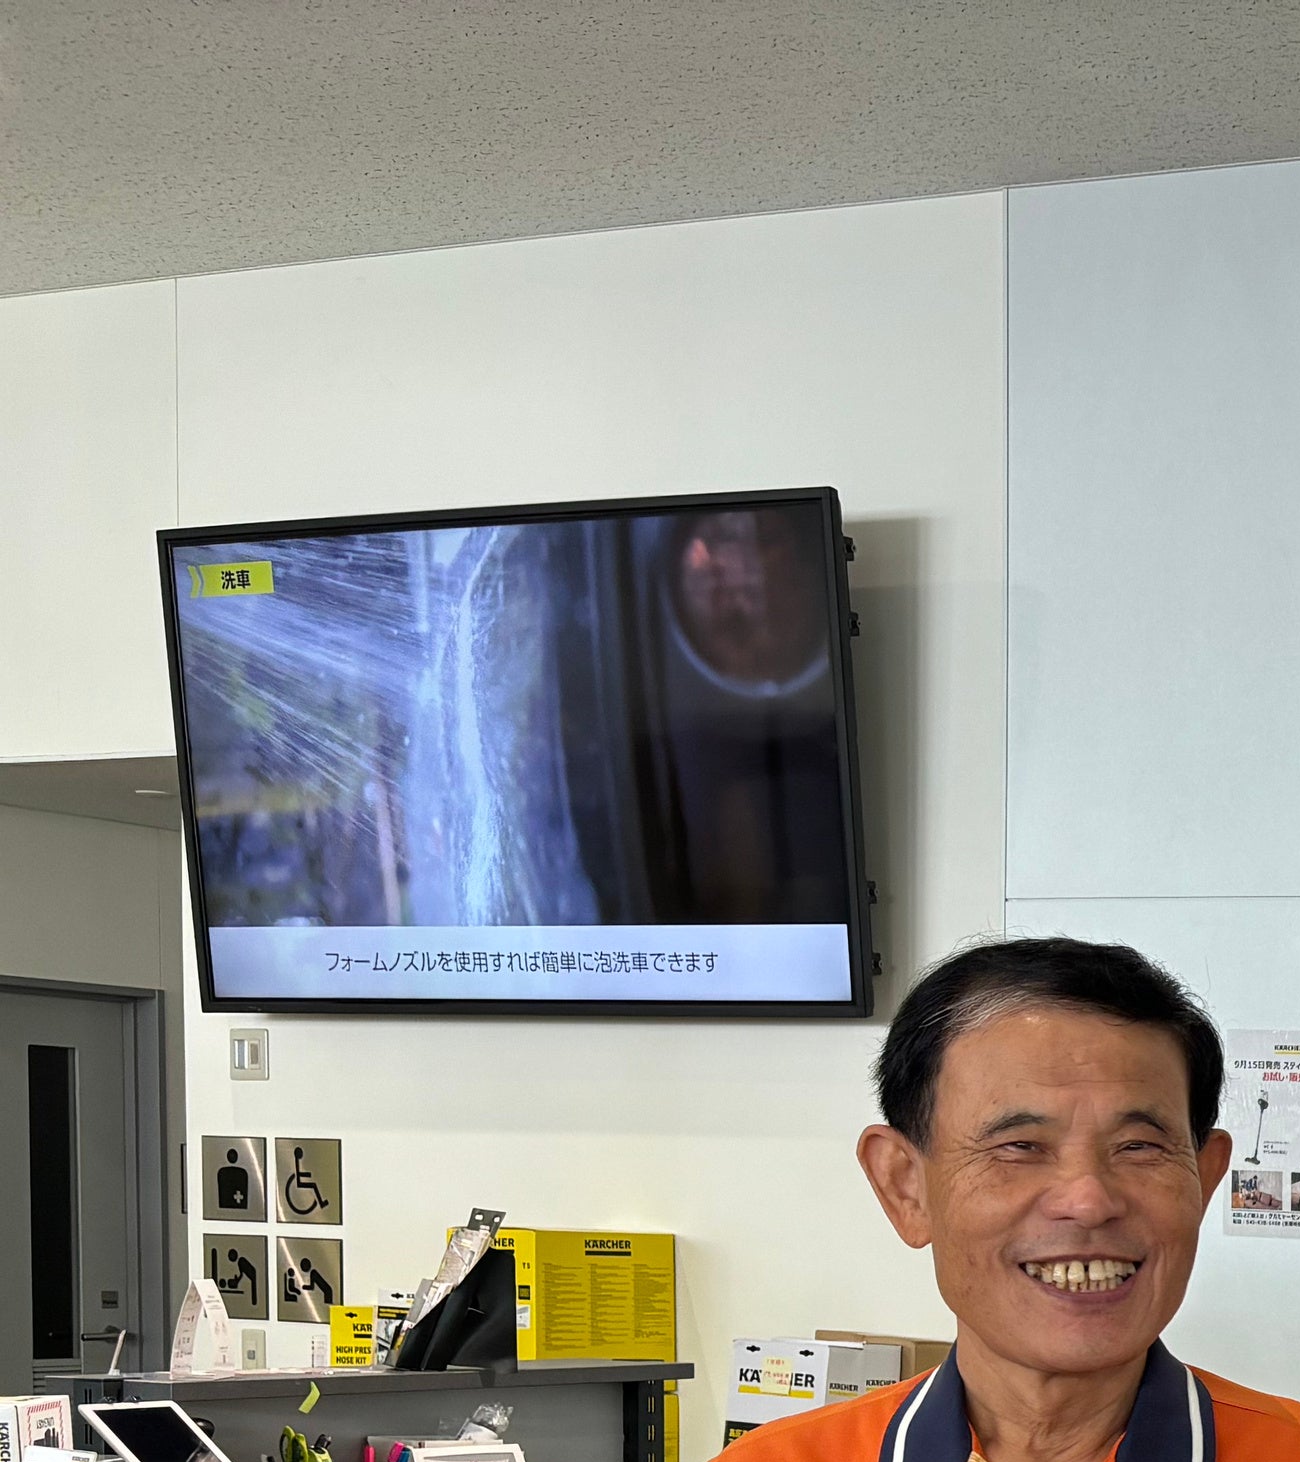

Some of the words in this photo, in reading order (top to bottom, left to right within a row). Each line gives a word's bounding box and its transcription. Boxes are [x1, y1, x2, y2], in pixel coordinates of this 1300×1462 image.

[221, 570, 251, 589] 洗車
[325, 951, 719, 974] フォームノズルを使用すれば簡単に泡洗車できます
[585, 1239, 631, 1249] KÄRCHER
[739, 1368, 815, 1388] KÄER
